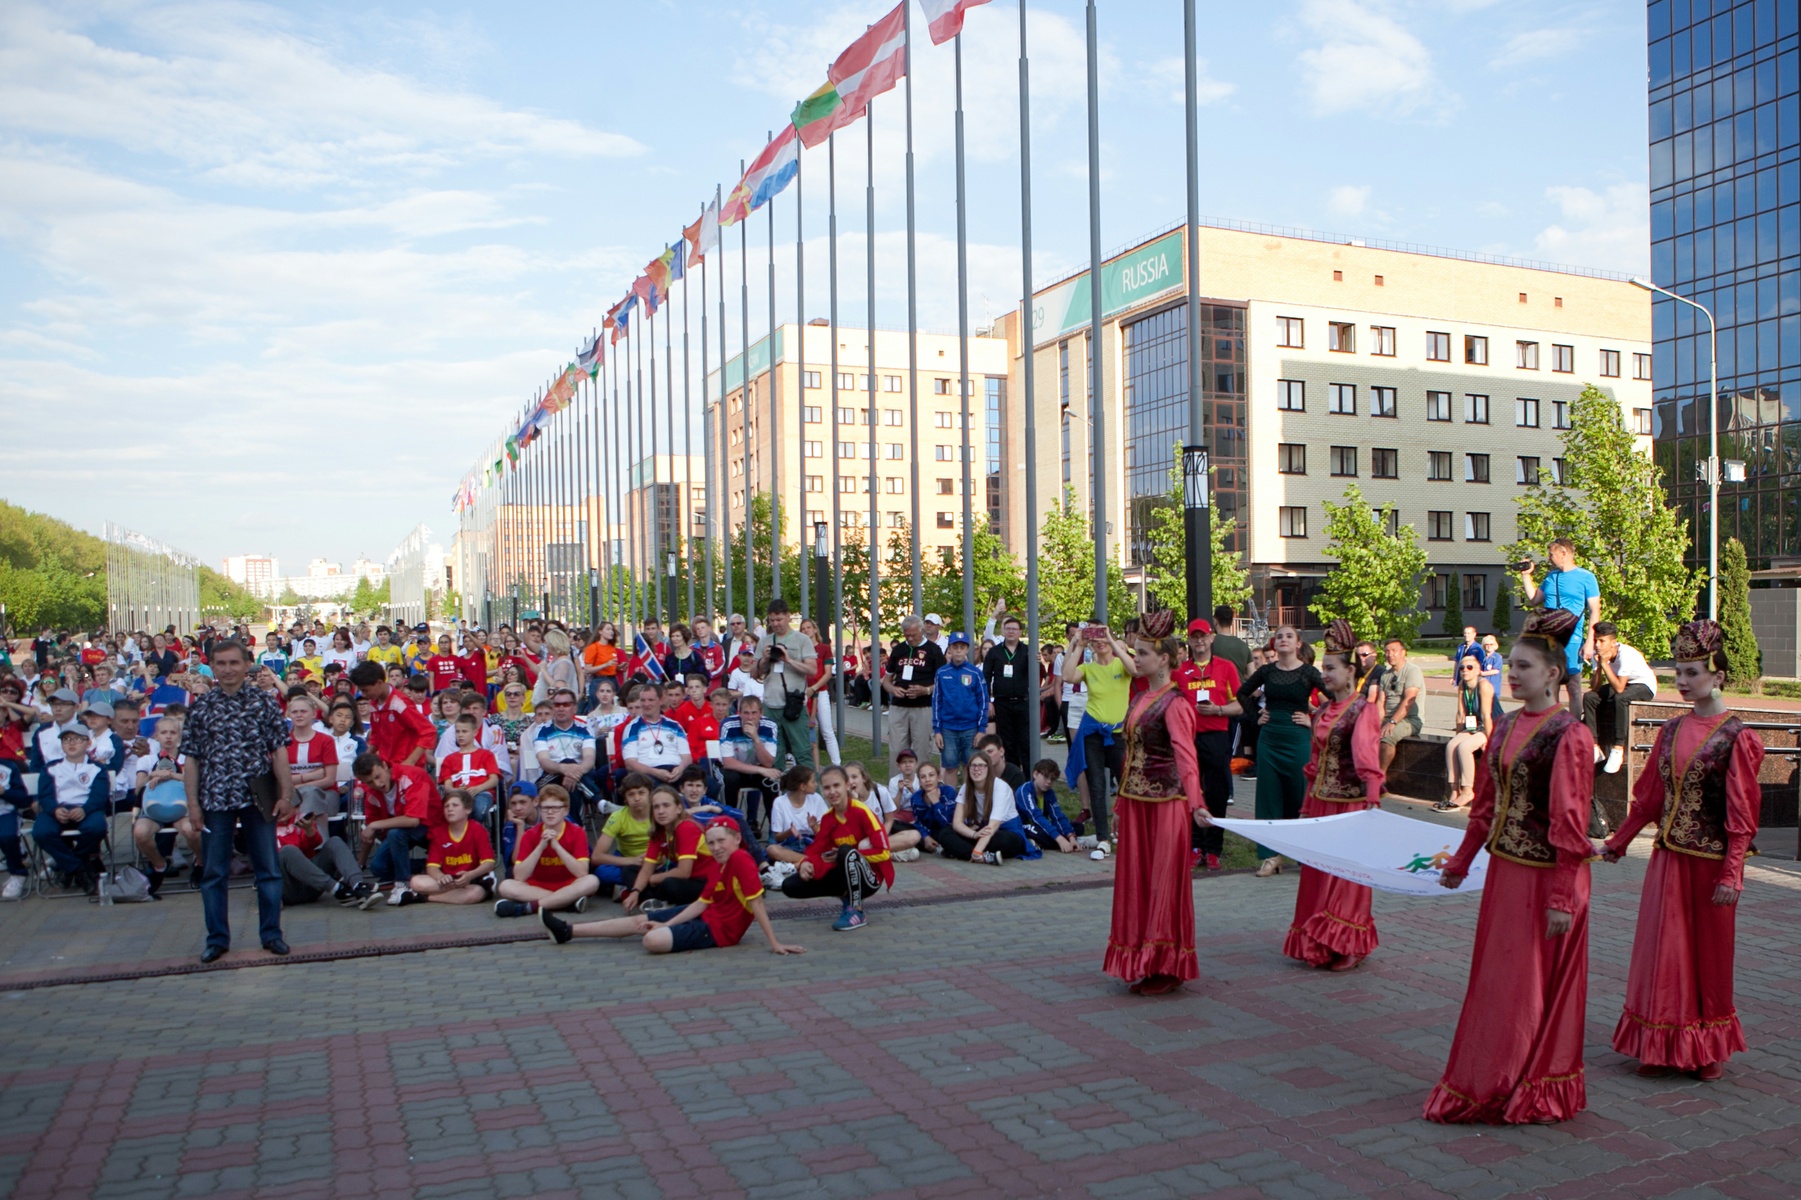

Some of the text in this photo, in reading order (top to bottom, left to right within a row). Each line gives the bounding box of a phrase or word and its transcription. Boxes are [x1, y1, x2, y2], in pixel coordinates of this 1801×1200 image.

[1122, 252, 1169, 294] RUSSIA
[898, 658, 926, 667] CZECH
[445, 853, 473, 866] ESPAÑA
